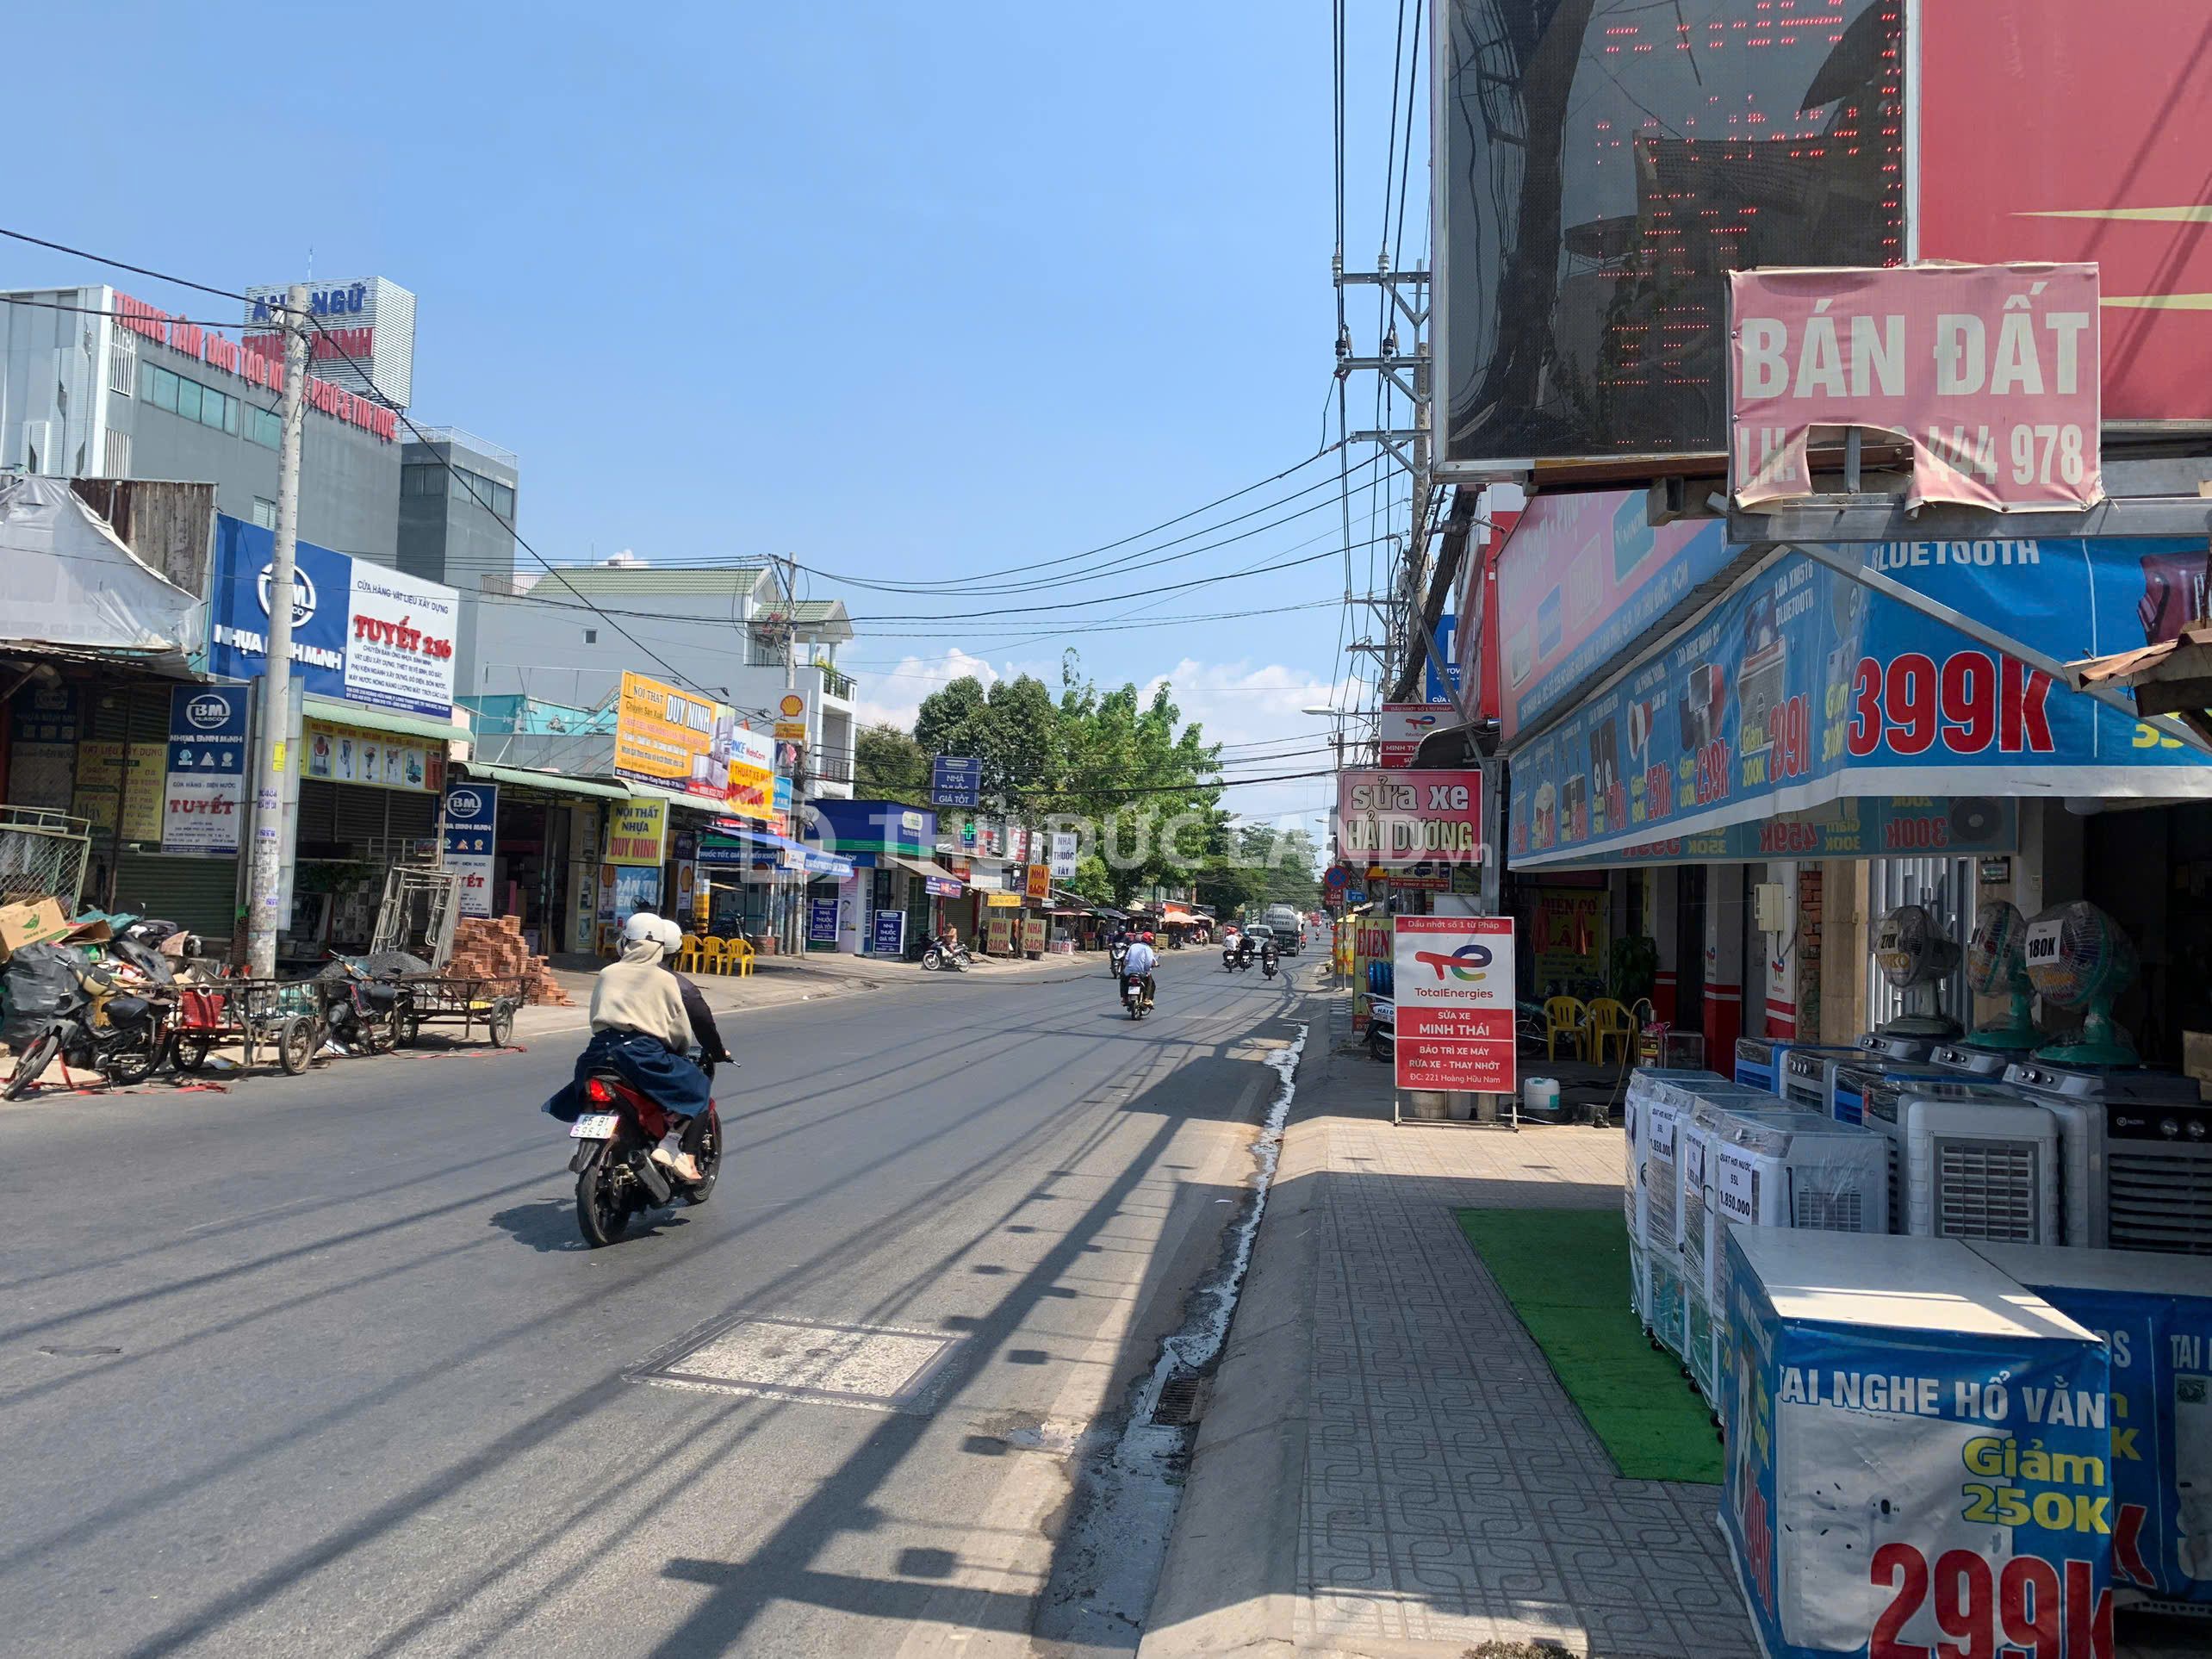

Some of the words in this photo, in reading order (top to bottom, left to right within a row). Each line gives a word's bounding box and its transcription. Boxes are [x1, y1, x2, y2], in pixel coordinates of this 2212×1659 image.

[1742, 299, 1905, 398] BÁN
[1933, 282, 2090, 395] ĐẤT
[113, 289, 166, 343] TRUNG
[171, 313, 202, 359] TÂM
[206, 331, 236, 372] ĐÀO
[239, 347, 264, 387] TẠO
[351, 396, 371, 430] TIN
[373, 407, 397, 441] HỌC
[2010, 425, 2084, 485] 978
[1871, 540, 2041, 571] BLUETOOTH
[357, 579, 371, 592] CỬA
[373, 584, 391, 598] HÀNG
[404, 593, 417, 606] LIỆU
[419, 598, 430, 609] XÂY
[432, 603, 449, 614] DỰNG
[1775, 587, 1814, 627] BLUETOOTH
[214, 624, 263, 655] NHỰA
[354, 615, 421, 652] TUYẾT
[665, 693, 687, 725] DUY
[687, 700, 711, 734] NINH
[170, 735, 195, 744] NHỰA
[170, 793, 234, 815] TUYẾT
[939, 793, 954, 803] GIÁ
[954, 793, 970, 804] TỐT
[1351, 776, 1418, 811] sửa
[1428, 785, 1469, 811] xe
[616, 808, 633, 820] NỘI
[636, 805, 659, 818] THẤT
[622, 822, 649, 835] NHỰA
[1347, 811, 1385, 851] HẢI
[1392, 817, 1474, 851] DƯƠNG
[611, 837, 632, 856] DUY
[633, 837, 658, 859] NINH
[1053, 850, 1075, 860] THUỐC
[1358, 920, 1390, 958] ĐIỆN
[1426, 920, 1445, 929] nhớt
[1448, 920, 1458, 929] số
[1467, 920, 1476, 929] từ
[1478, 921, 1500, 930] Pháp
[2029, 937, 2056, 959] 180K
[1414, 987, 1494, 1000] TotalEnergies
[1420, 1024, 1454, 1035] MINH
[1457, 1022, 1489, 1036] THÁI
[1438, 1010, 1457, 1020] SỬA
[1409, 1057, 1427, 1067] RỬA
[1474, 1059, 1501, 1070] NHỚT
[1420, 1045, 1438, 1054] BẢO
[1440, 1045, 1455, 1054] TRÌ
[1470, 1046, 1489, 1056] MÁY
[1441, 1074, 1464, 1084] Hoàng
[1467, 1073, 1482, 1083] Hữu
[1483, 1075, 1501, 1084] Nam
[1720, 1190, 1750, 1217] 1.850.000
[2171, 1334, 2201, 1370] TAI
[1833, 1372, 1940, 1416] NGHE
[1954, 1370, 2010, 1422] HỔ
[2022, 1381, 2107, 1430] VẰN
[1961, 1436, 2105, 1488] Giảm
[1961, 1482, 2111, 1535] 250K
